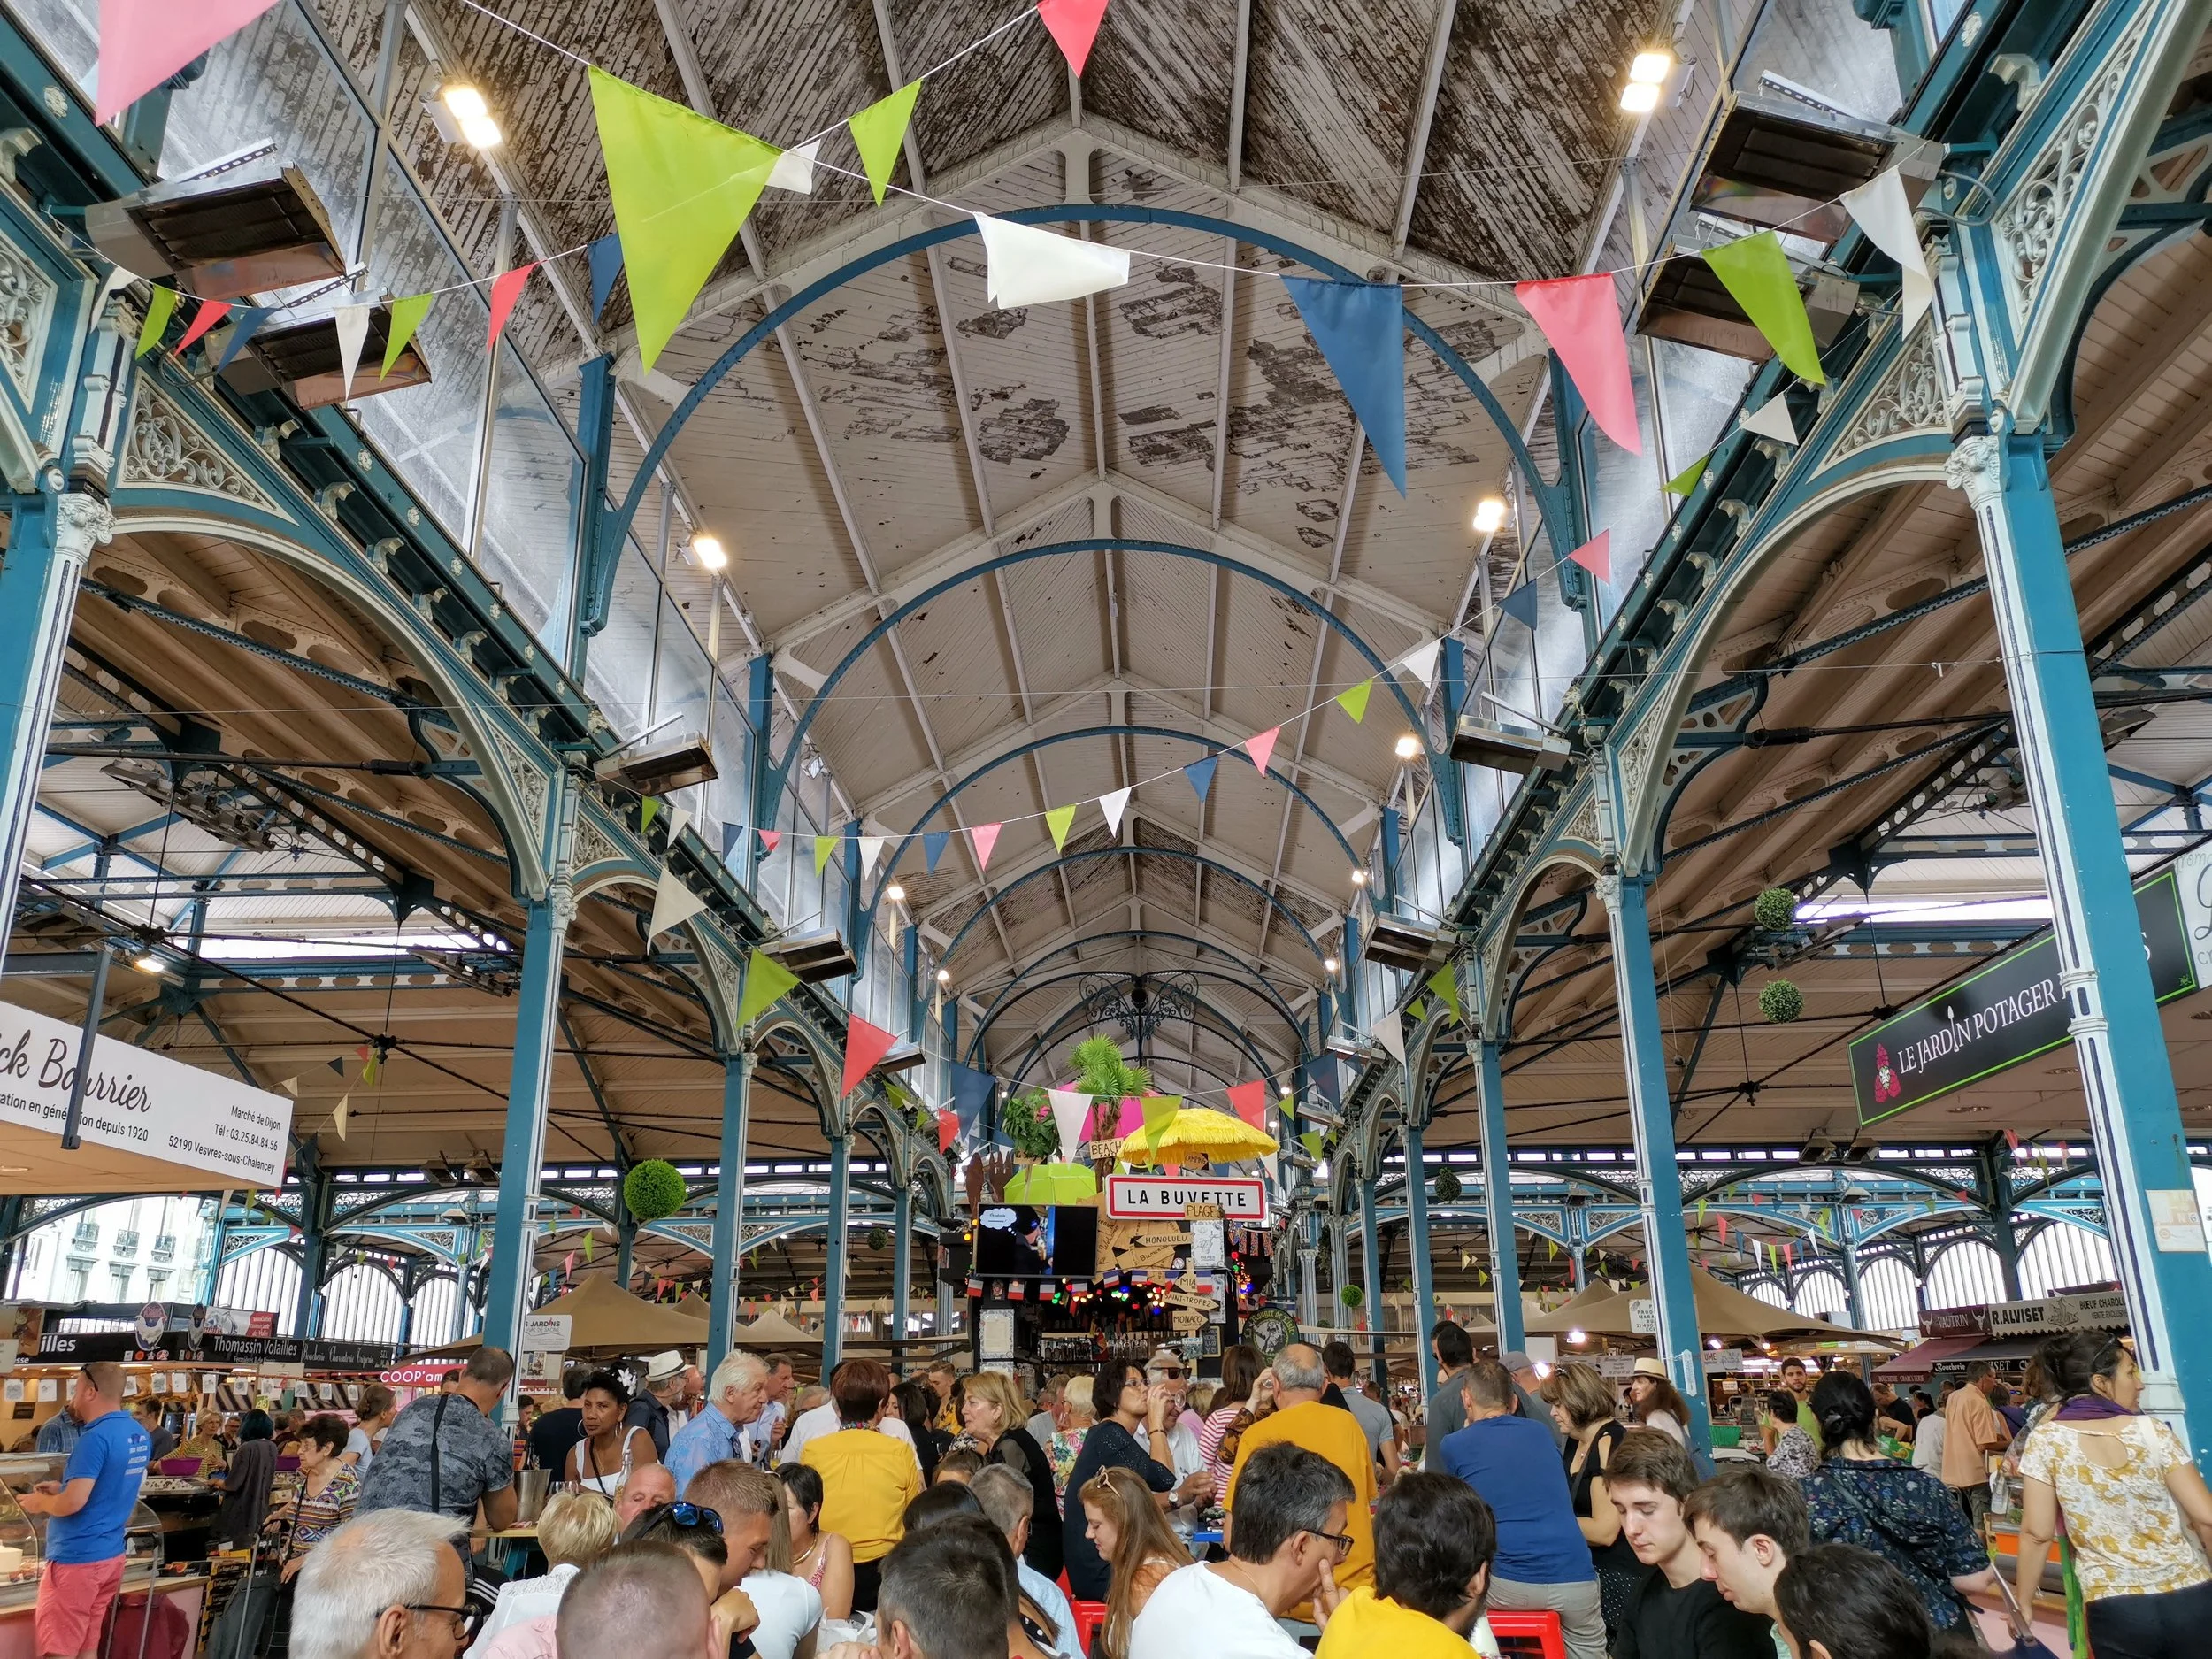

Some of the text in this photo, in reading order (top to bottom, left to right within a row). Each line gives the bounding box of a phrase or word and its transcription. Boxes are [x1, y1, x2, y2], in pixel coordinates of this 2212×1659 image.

[1898, 979, 2058, 1074] LE JARDIN POTAGER
[0, 1029, 30, 1079] ck
[29, 1102, 41, 1114] en
[43, 1103, 93, 1128] généion
[96, 1117, 125, 1135] depuis
[128, 1125, 149, 1141] 1920
[231, 1105, 281, 1131] Marché de Dijon
[230, 1128, 278, 1152] 03.25.84.84.56
[1091, 1141, 1121, 1155] BEACH
[168, 1136, 275, 1175] 52190 Vesvres-sous-Chalancey
[1127, 1189, 1247, 1207] LA BUVETTE
[1145, 1235, 1187, 1244] HONOLULU
[1164, 1294, 1211, 1308] SAINT-TROPEZ
[530, 1318, 560, 1327] JARDINS
[1173, 1315, 1202, 1324] MONACO
[1937, 1314, 1969, 1328] VAUTRIN
[1992, 1306, 2044, 1325] R.ALVISET
[214, 1336, 297, 1356] Thomassin Volailles
[1935, 1363, 1965, 1372] Boucherie
